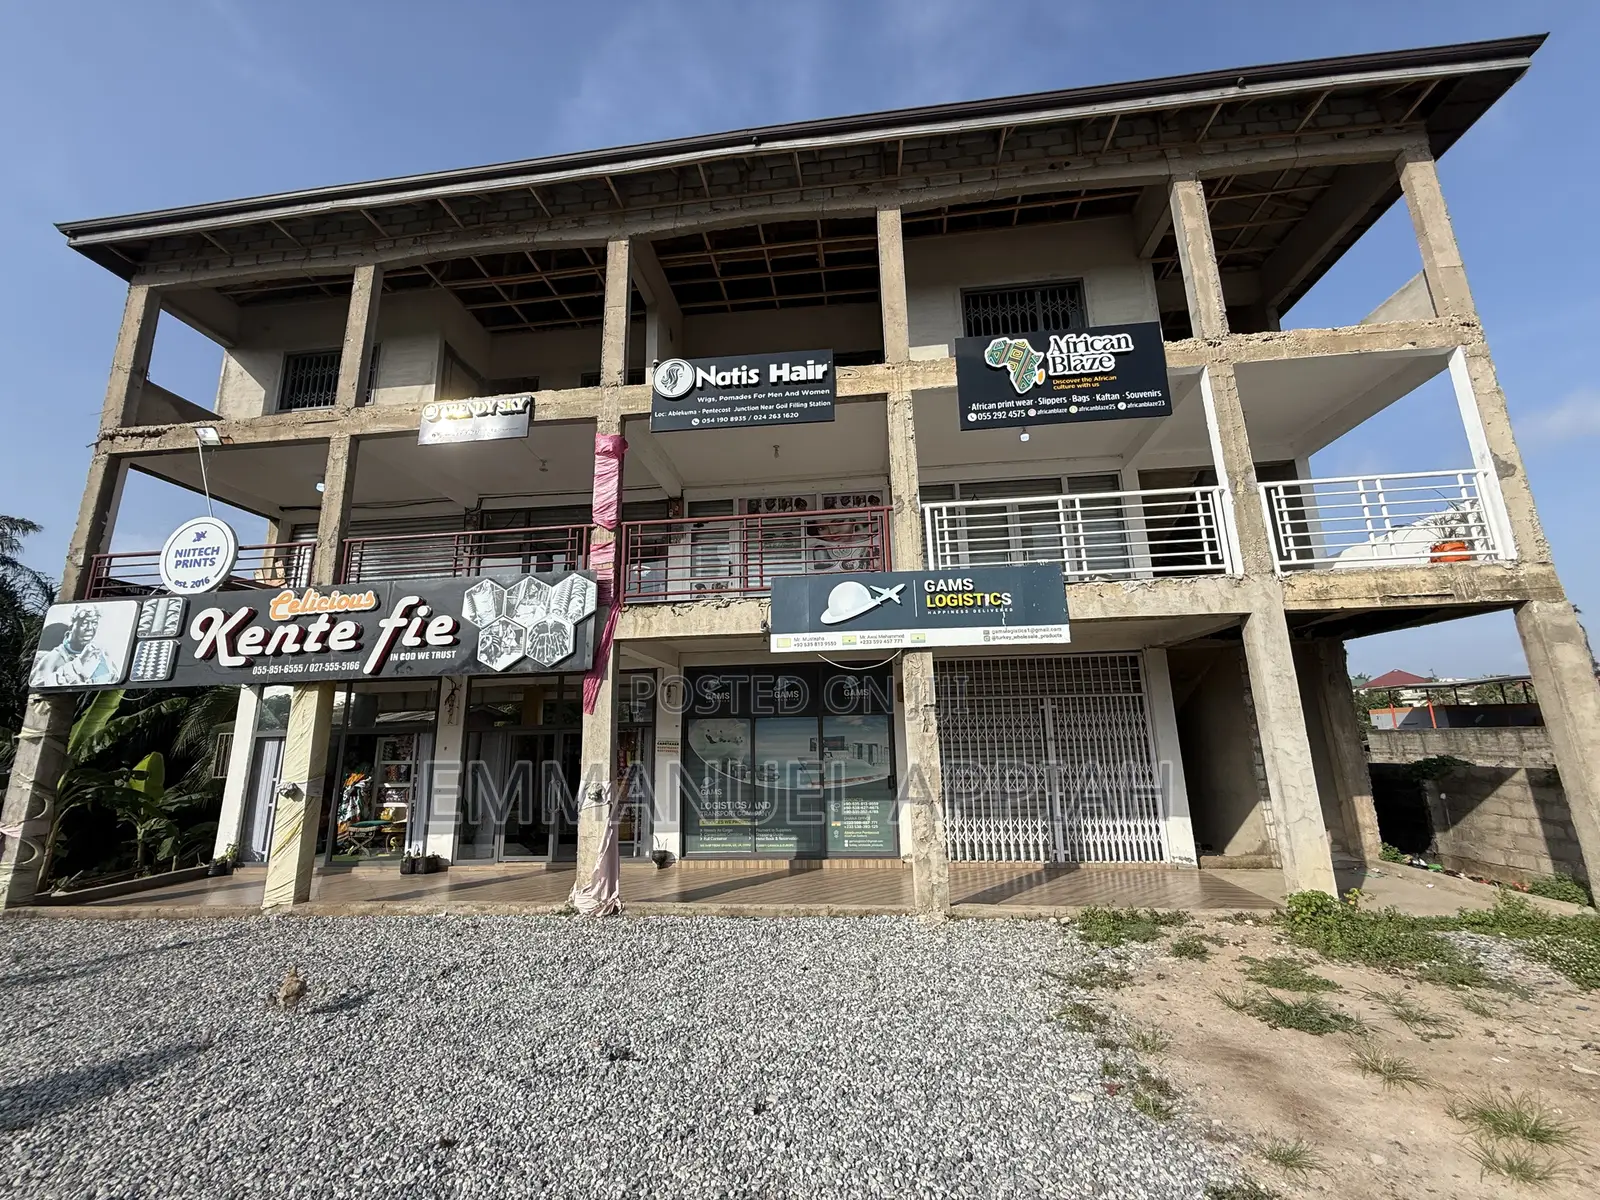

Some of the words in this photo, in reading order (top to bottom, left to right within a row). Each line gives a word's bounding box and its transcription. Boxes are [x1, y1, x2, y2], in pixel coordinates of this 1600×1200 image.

[1049, 335, 1132, 355] African
[1050, 354, 1115, 374] Blaze
[696, 365, 760, 388] Natis
[769, 360, 828, 383] Hair
[697, 396, 718, 404] Wigs,
[719, 394, 752, 402] Pomades
[784, 389, 800, 397] And
[801, 388, 830, 396] Women
[971, 401, 997, 411] African
[997, 400, 1014, 410] print
[1016, 399, 1034, 408] wear
[1037, 397, 1067, 407] Slippers
[1072, 394, 1090, 404] Bags
[1096, 392, 1120, 402] Kaftan
[1126, 389, 1162, 399] Souvenirs
[498, 397, 528, 412] SKY
[702, 406, 731, 415] Pentecost
[734, 404, 759, 413] Junction
[760, 403, 774, 411] Near
[789, 401, 808, 410] Filling
[809, 400, 831, 408] Station
[1037, 407, 1067, 416] africanblaze
[977, 412, 991, 421] 055
[992, 411, 1006, 420] 292
[1007, 410, 1026, 419] 4575
[174, 546, 220, 559] NIITECH
[174, 557, 216, 569] PRINTS
[174, 579, 188, 589] est.
[190, 576, 210, 588] 2016
[924, 578, 974, 592] GAMS
[269, 588, 376, 621] Celicious
[926, 592, 1013, 608] LOGISTICS
[189, 606, 357, 667] Kente
[363, 595, 455, 674] fie
[390, 652, 399, 661] IN
[417, 651, 430, 660] WE
[431, 650, 457, 659] TRUST
[252, 664, 303, 675] 055-851-6555
[309, 661, 360, 672] 027-555-5166
[774, 690, 799, 698] GAMS
[844, 689, 869, 697] GAMS
[700, 788, 722, 796] GAMS
[700, 801, 747, 810] LOGISTICS
